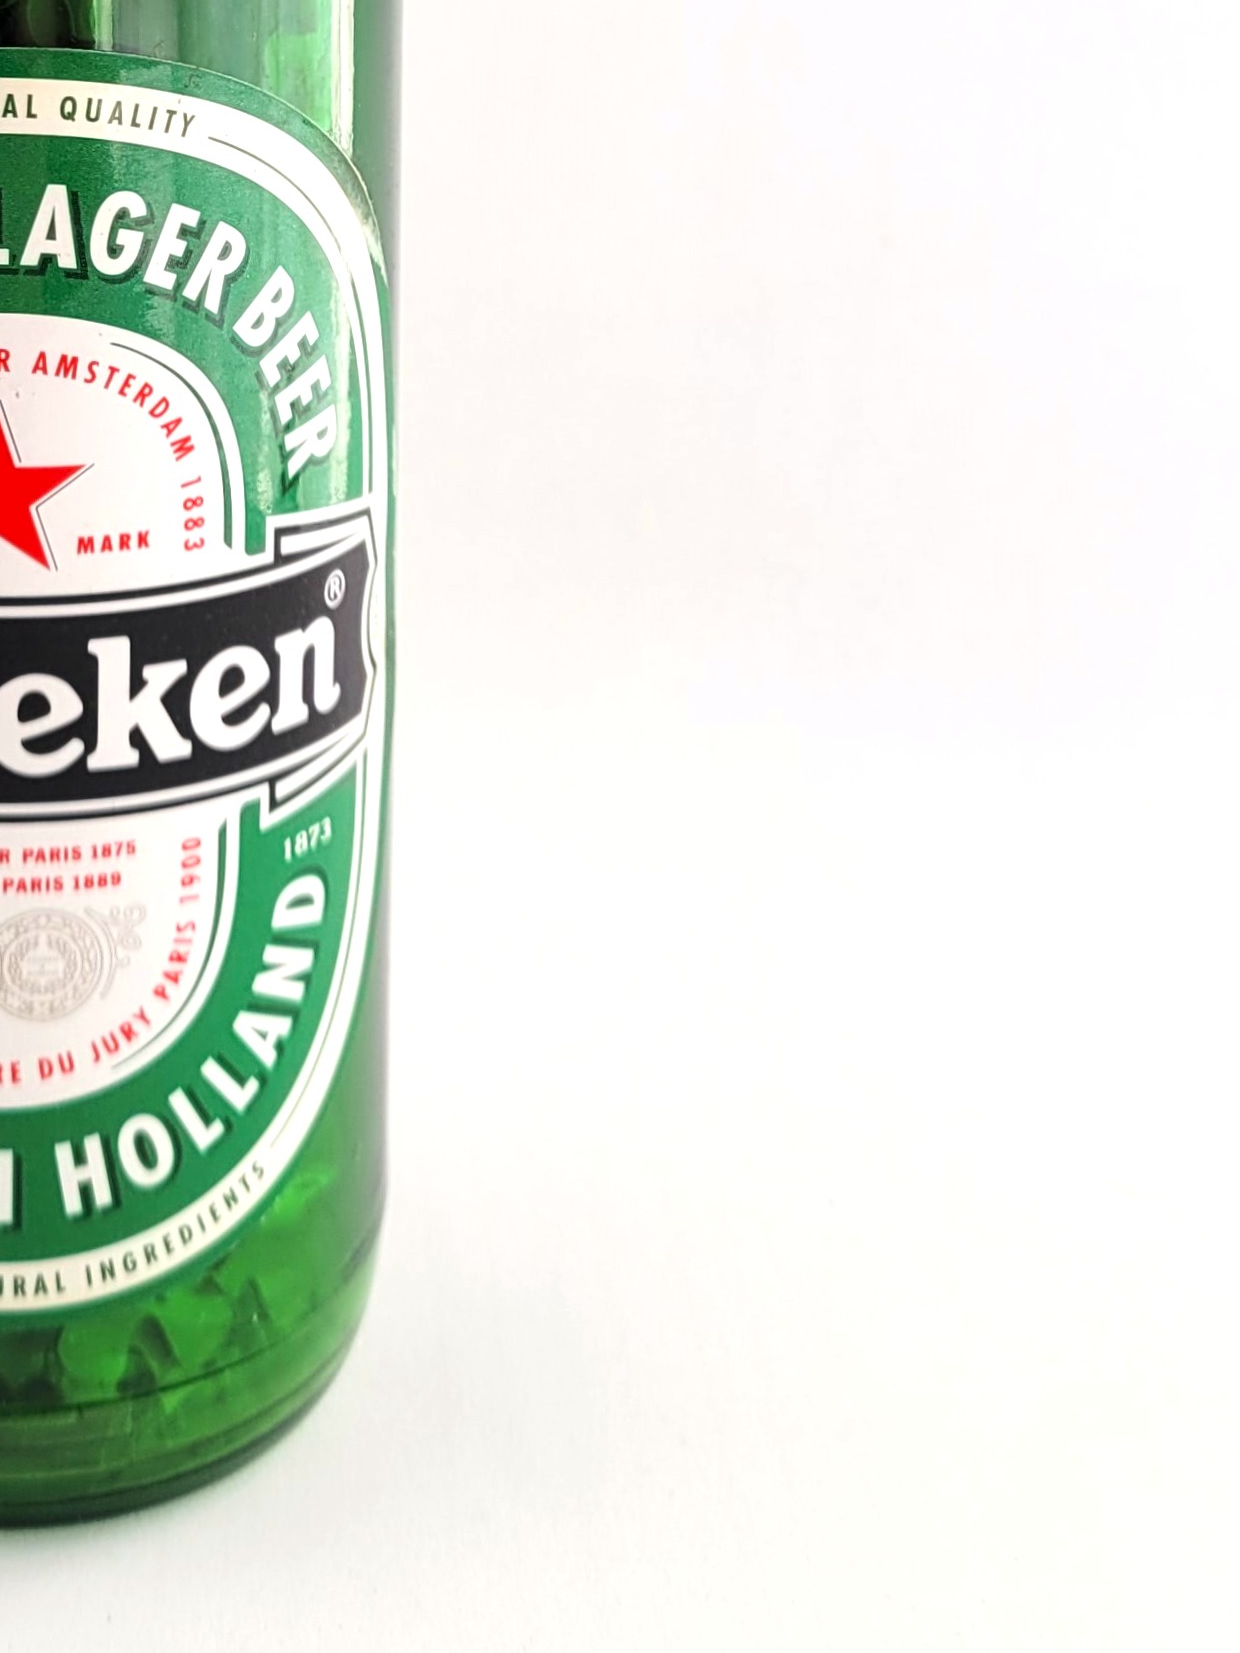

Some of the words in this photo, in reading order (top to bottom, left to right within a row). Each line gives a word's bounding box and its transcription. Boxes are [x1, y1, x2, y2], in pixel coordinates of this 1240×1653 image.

[60, 95, 197, 139] QUALITY
[232, 265, 339, 482] BEER
[32, 350, 196, 462] AMSTERDAM
[180, 476, 205, 552] 1883
[76, 530, 151, 555] MARK
[2, 876, 64, 894] PARIS
[72, 870, 122, 891] 1889
[22, 845, 82, 864] PARIS
[91, 839, 136, 861] 1875
[284, 816, 332, 862] 1873
[38, 1051, 75, 1081] DU
[91, 1009, 153, 1064] JURY
[153, 920, 196, 1001] PARIS
[179, 836, 203, 903] 1900
[54, 872, 328, 1219] HOLLAND
[86, 1160, 265, 1288] INGREDIENTS
